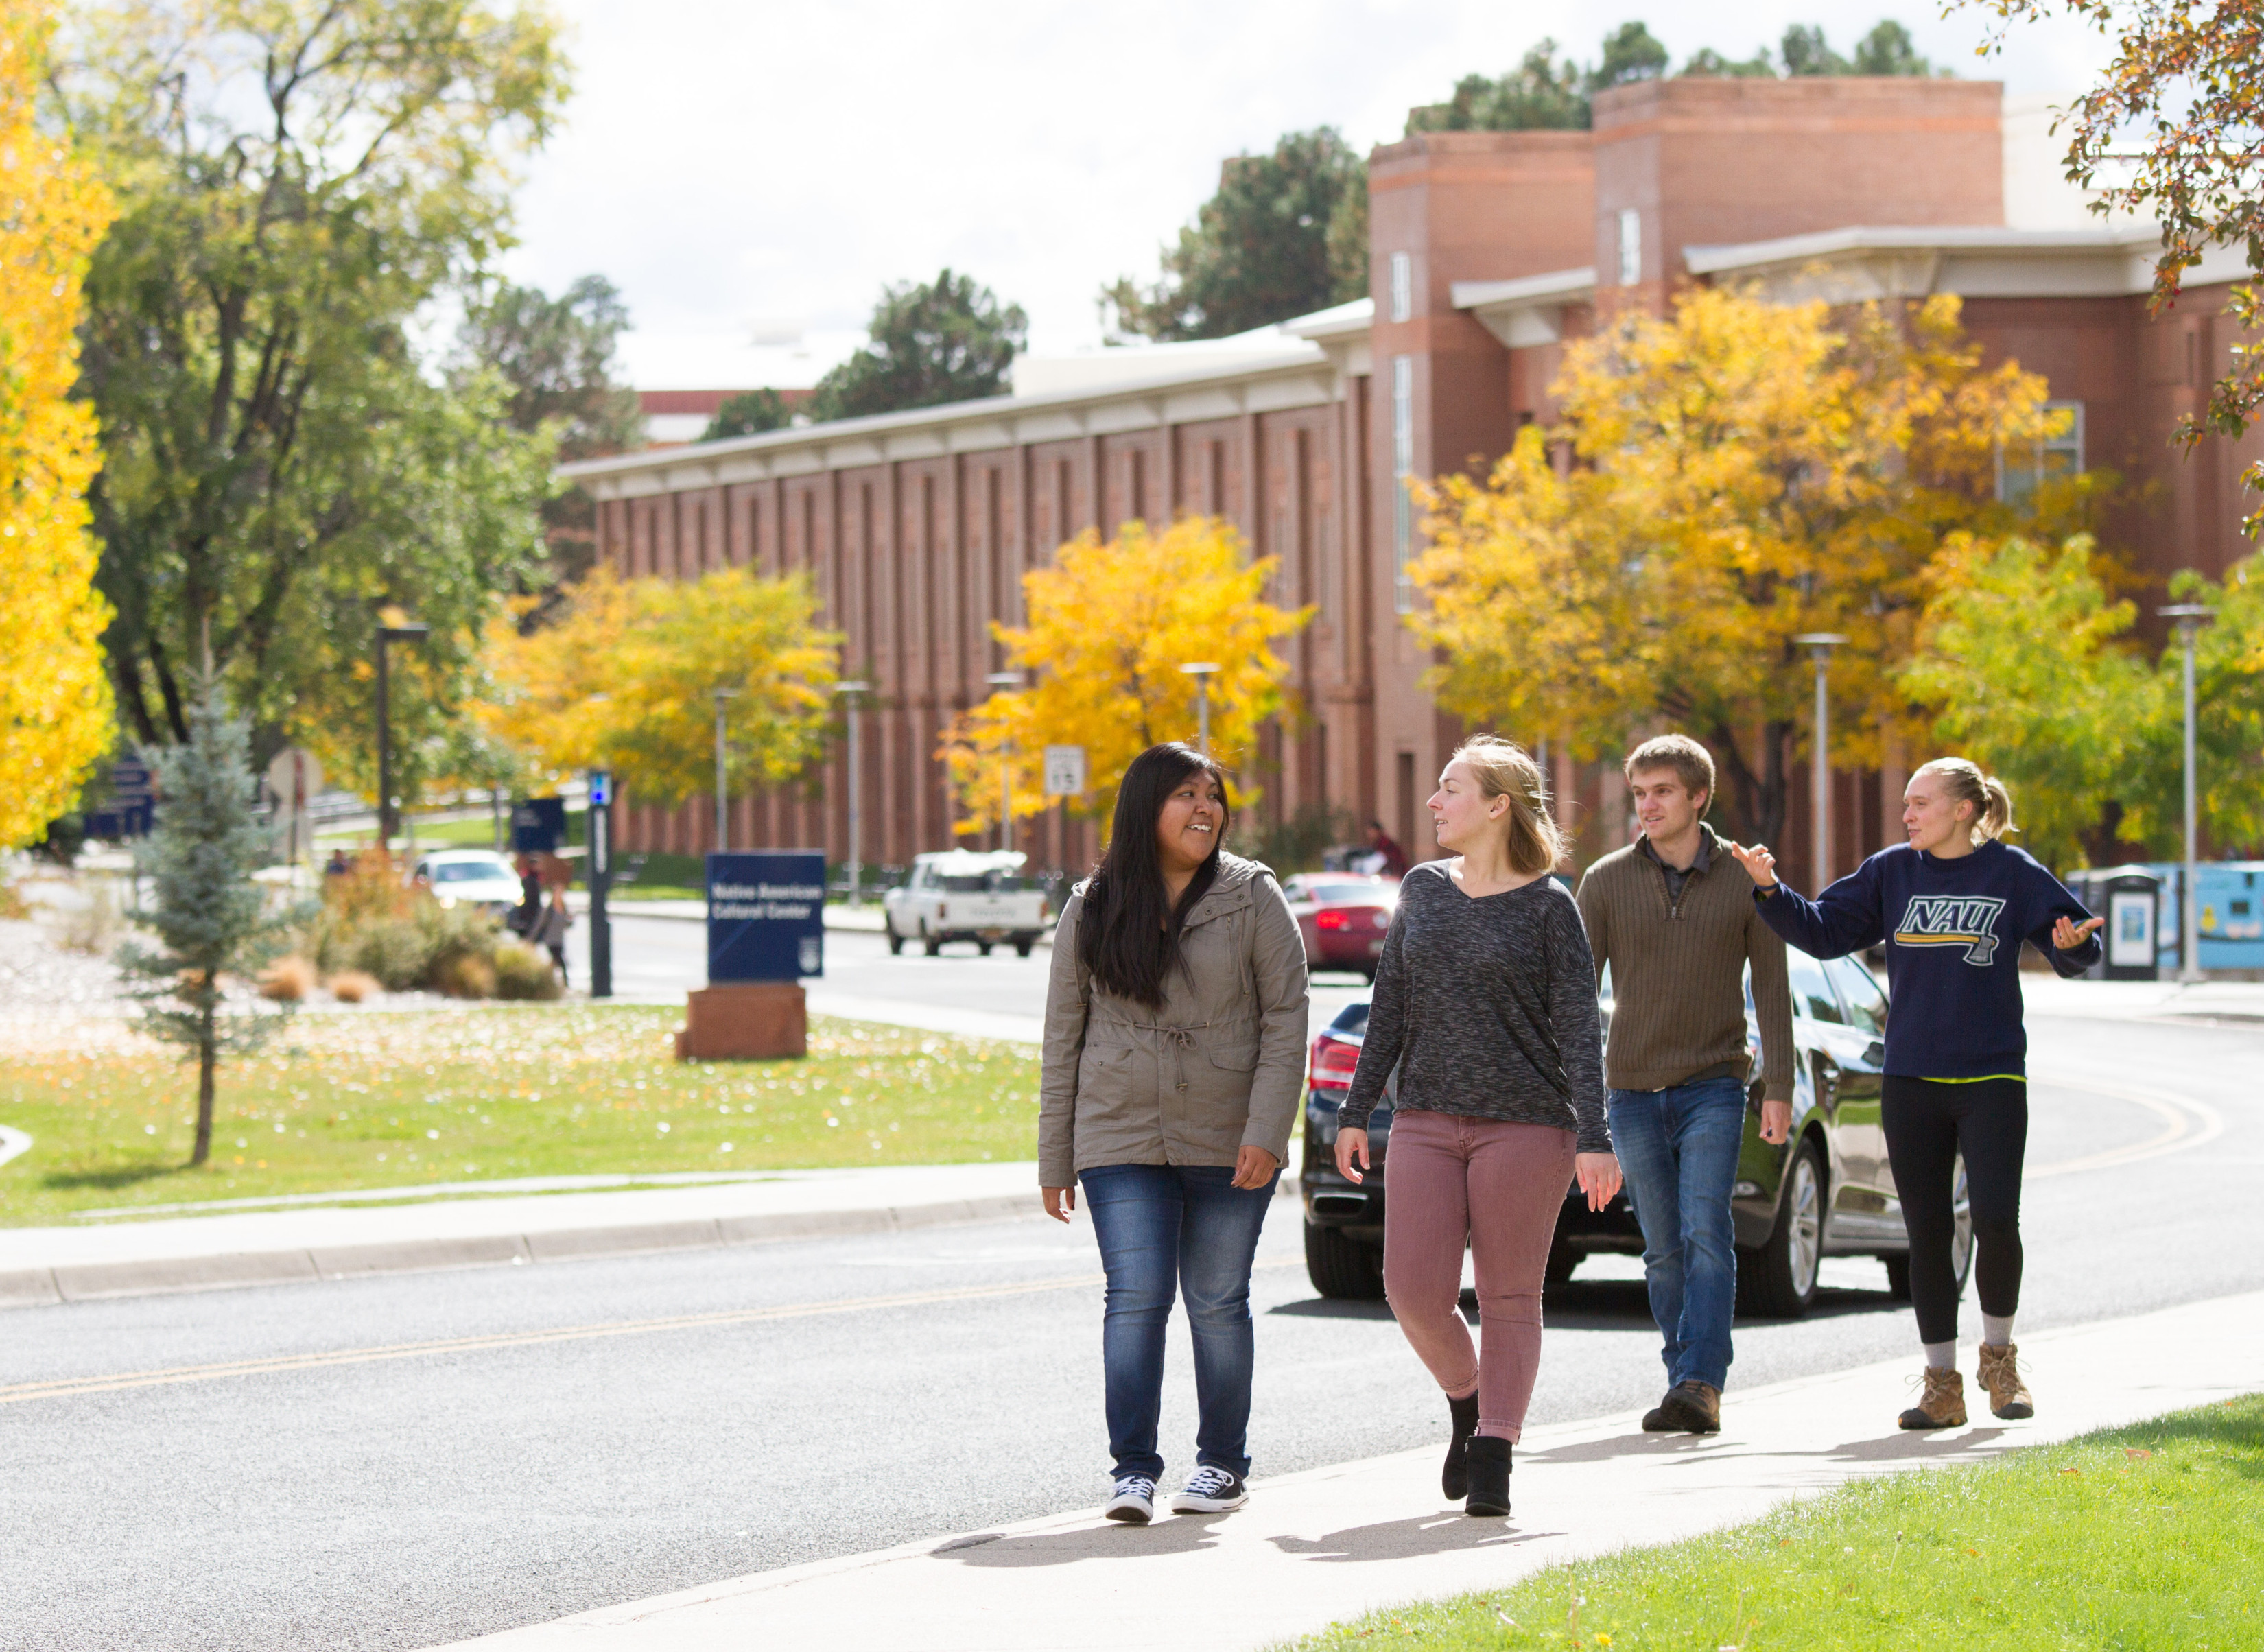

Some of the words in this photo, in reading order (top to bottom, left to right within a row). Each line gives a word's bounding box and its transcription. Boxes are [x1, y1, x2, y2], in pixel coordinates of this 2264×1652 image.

[711, 882, 755, 899] Native
[759, 882, 822, 899] American
[766, 903, 811, 919] Center
[1902, 899, 1999, 934] NAU
